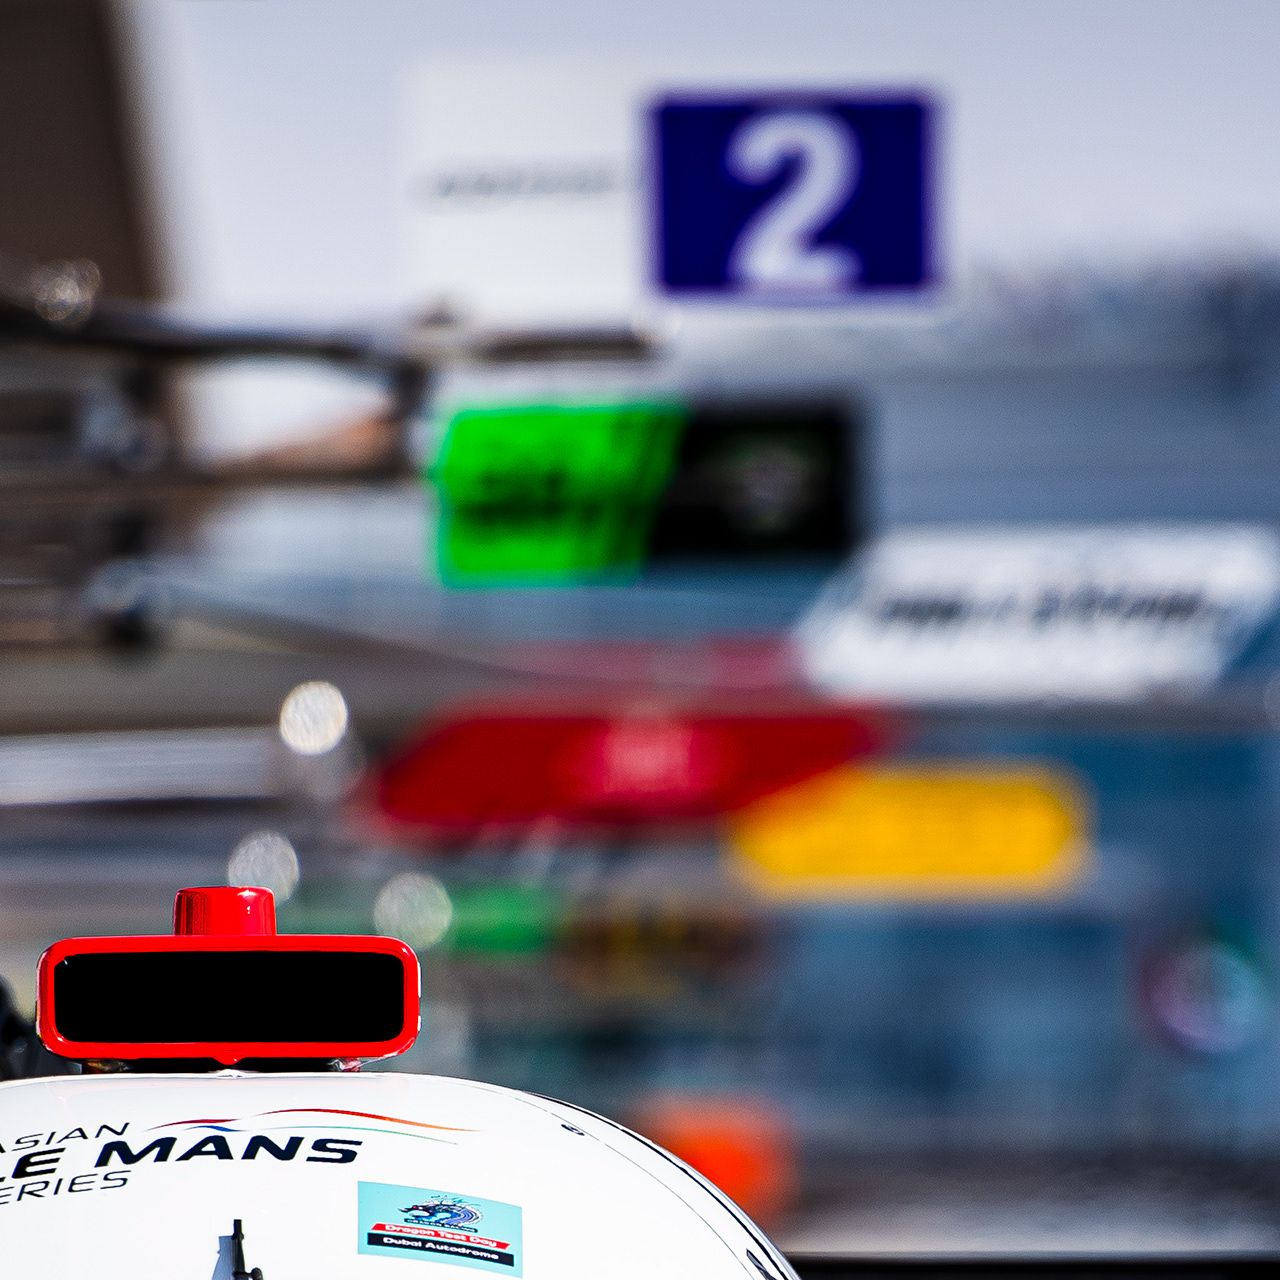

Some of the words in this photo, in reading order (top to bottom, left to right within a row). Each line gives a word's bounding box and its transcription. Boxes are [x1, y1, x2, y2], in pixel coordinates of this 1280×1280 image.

[721, 106, 865, 289] 2
[94, 1134, 363, 1168] MANS
[382, 1236, 422, 1247] Dubai
[424, 1242, 499, 1260] Autodrome
[384, 1224, 435, 1237] Dragon
[437, 1230, 467, 1242] Test
[469, 1235, 497, 1248] Day
